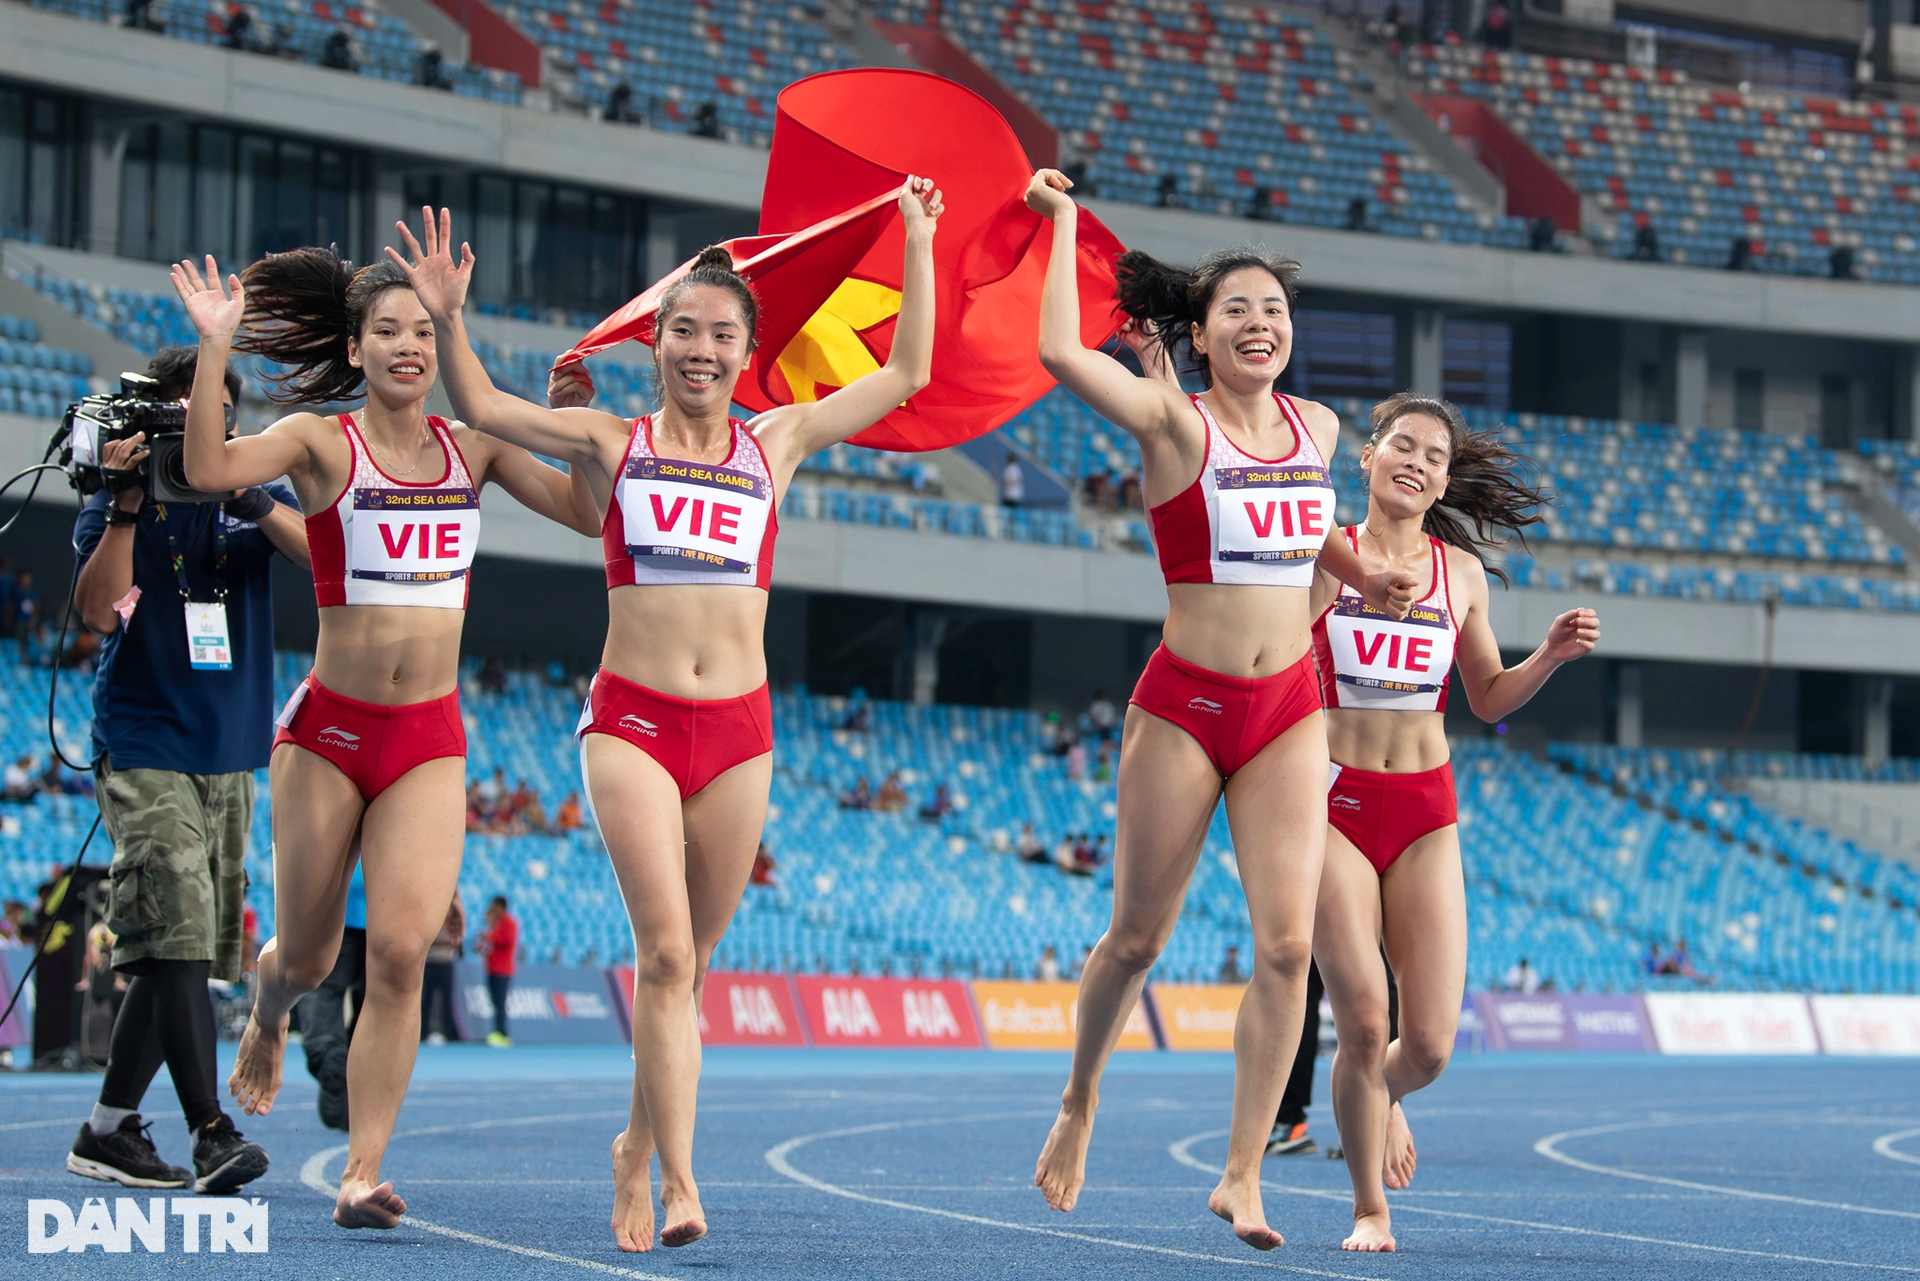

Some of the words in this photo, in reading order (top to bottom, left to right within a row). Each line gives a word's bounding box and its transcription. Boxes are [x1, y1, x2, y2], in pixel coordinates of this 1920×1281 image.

[659, 464, 687, 477] 32nd
[689, 468, 713, 481] SEA
[715, 473, 754, 490] GAMES
[1246, 472, 1271, 482] 32nd
[1272, 471, 1292, 482] SEA
[1293, 471, 1324, 482] GAMES
[385, 495, 411, 505] 32nd
[413, 495, 434, 505] SEA
[437, 494, 468, 504] GAMES
[649, 493, 742, 545] VIE
[1243, 500, 1324, 538] VIE
[377, 523, 461, 559] VIE
[681, 549, 697, 559] LIVE
[697, 551, 705, 560] IN
[706, 553, 725, 566] PEACE
[1296, 550, 1305, 558] IN
[413, 573, 427, 581] LIVE
[1411, 609, 1440, 623] GAMES
[1352, 630, 1433, 673] VIE
[1188, 703, 1222, 715] LI-NING
[618, 721, 658, 738] LI-NING
[317, 735, 360, 751] LI-NING
[1331, 801, 1361, 811] LI-NING
